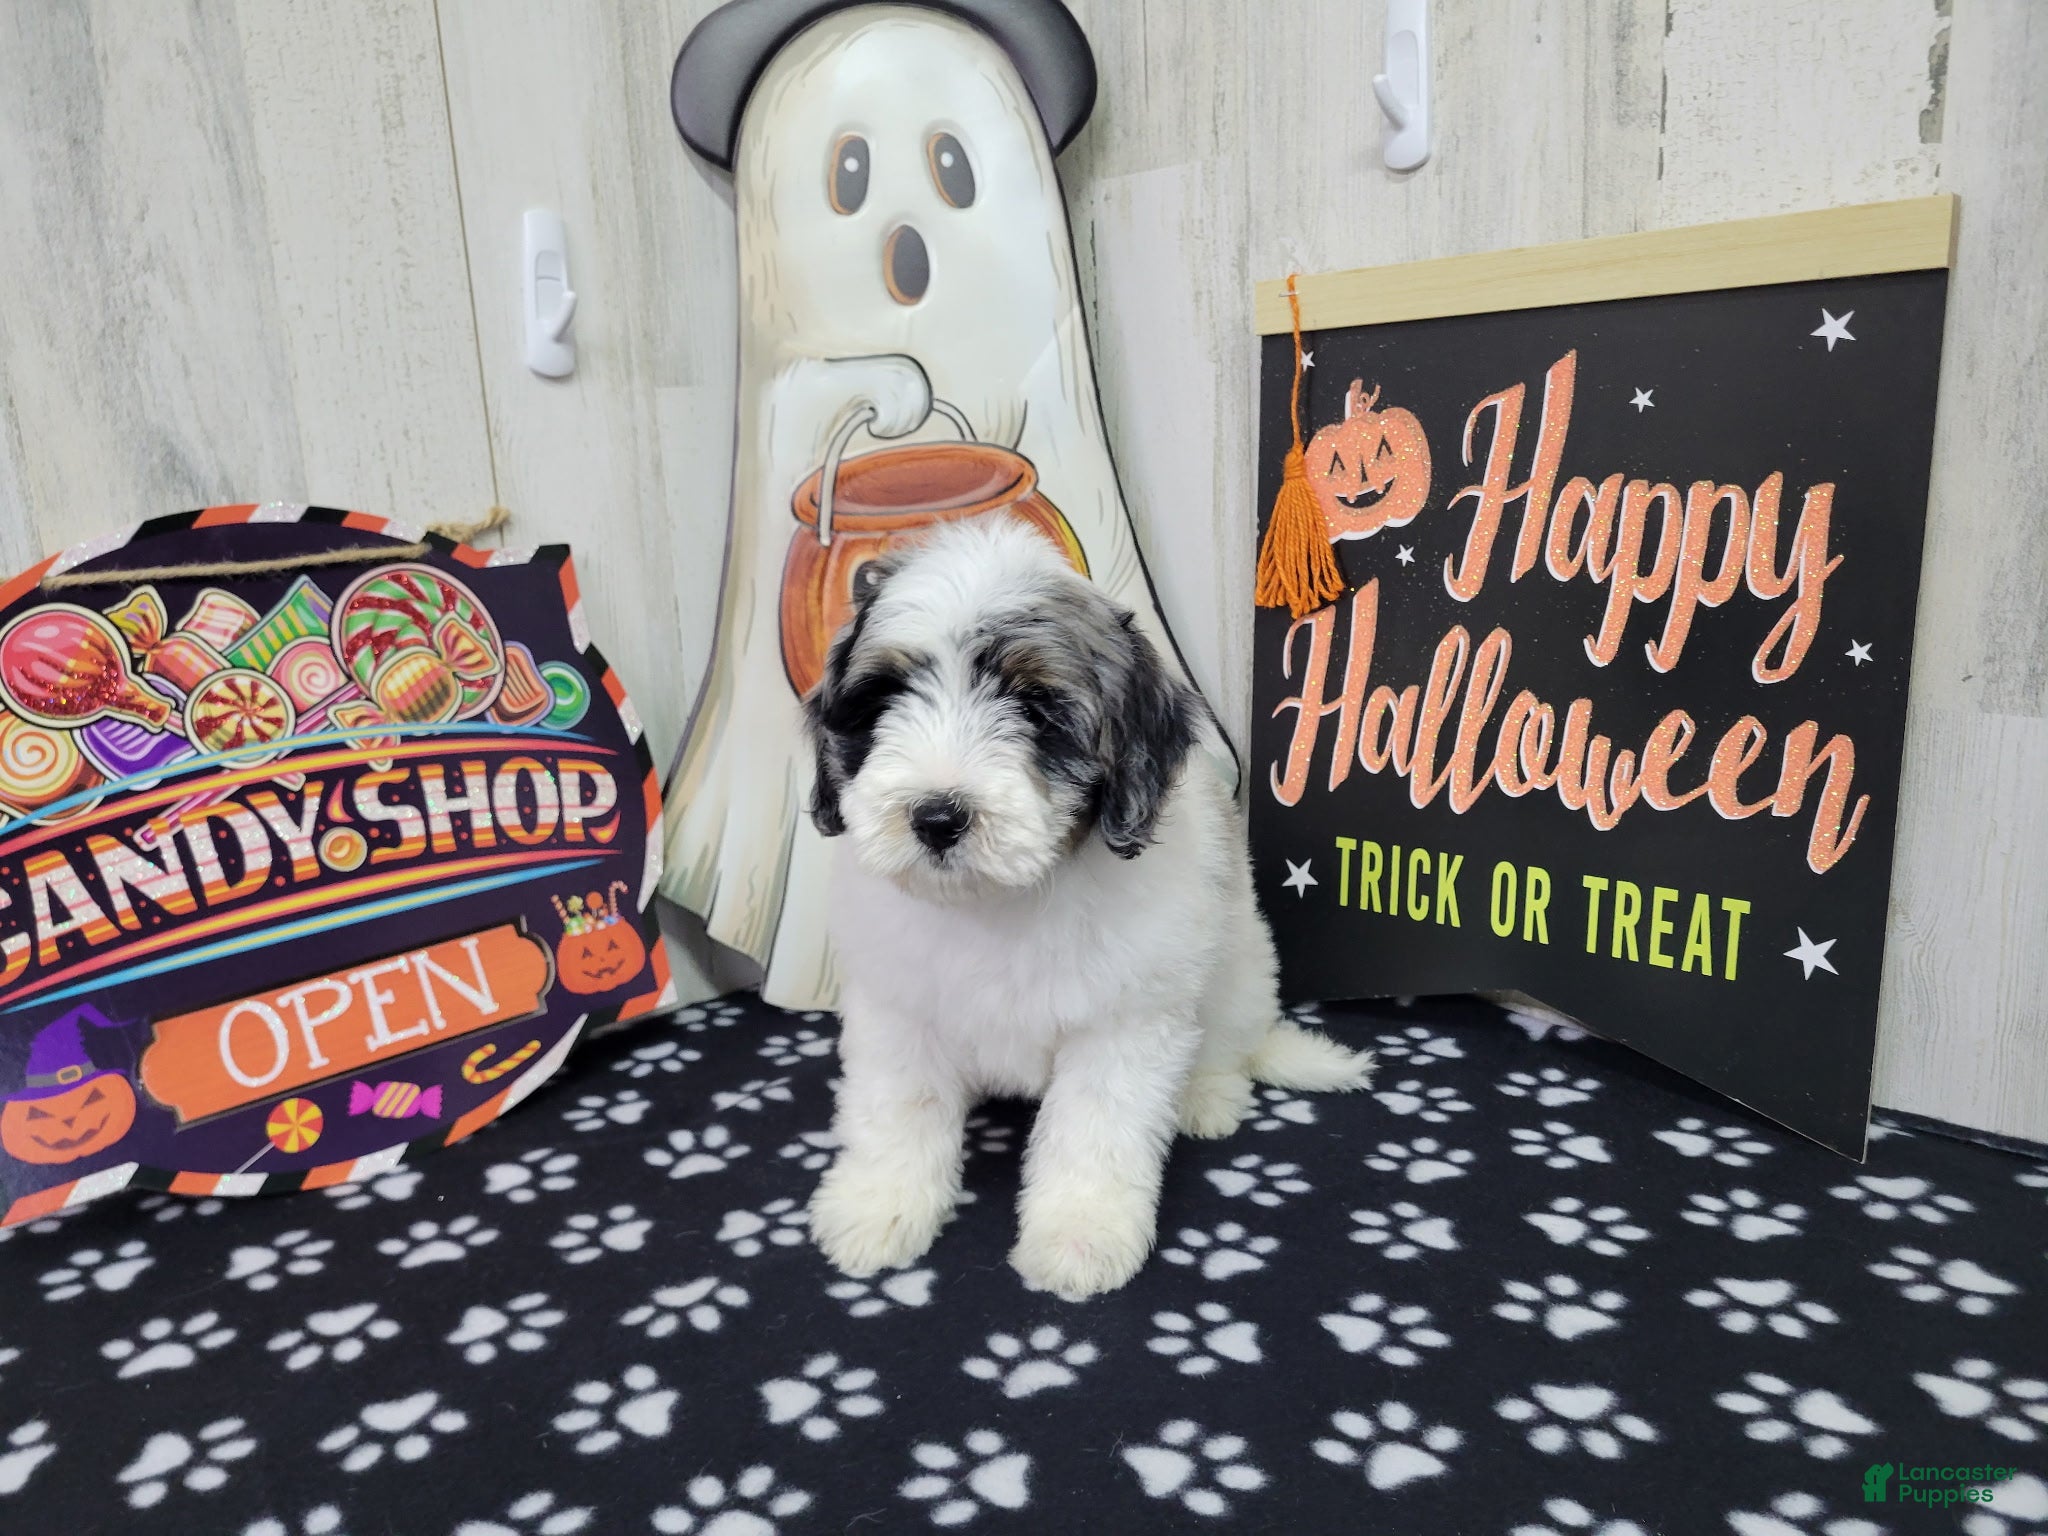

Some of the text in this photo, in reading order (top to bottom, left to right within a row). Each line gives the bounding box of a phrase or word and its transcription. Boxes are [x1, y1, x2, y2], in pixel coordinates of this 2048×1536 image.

[1445, 348, 1844, 684] Happy
[1270, 577, 1869, 875] Halloween
[353, 756, 618, 865] SHOP
[1335, 835, 1752, 981] TRICK OR TREAT
[219, 937, 500, 1088] OPEN
